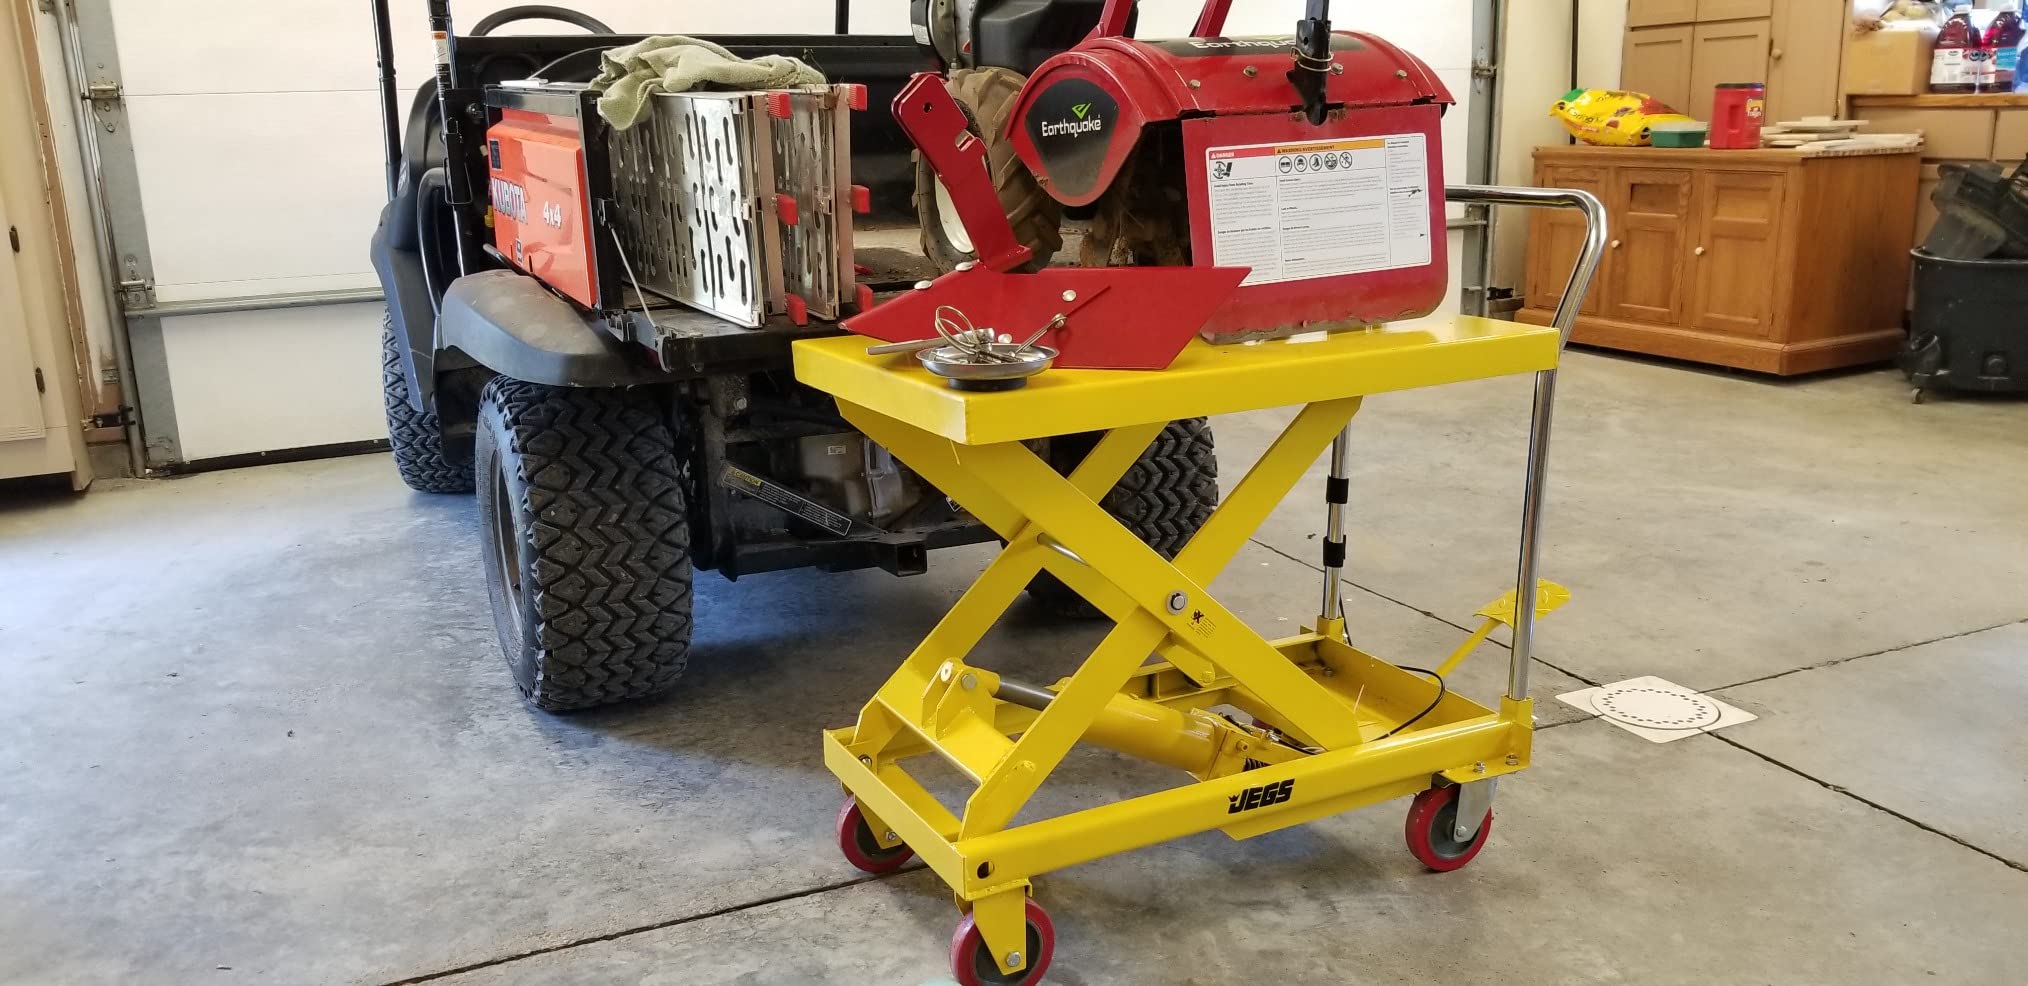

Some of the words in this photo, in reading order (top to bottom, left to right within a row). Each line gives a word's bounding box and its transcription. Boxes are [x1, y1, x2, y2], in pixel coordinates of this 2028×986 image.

[1188, 40, 1297, 49] Earthqua
[1041, 114, 1102, 138] Earthquake
[491, 177, 528, 224] KUBOTA
[543, 200, 562, 228] 4x4
[1227, 778, 1296, 815] JEGS
